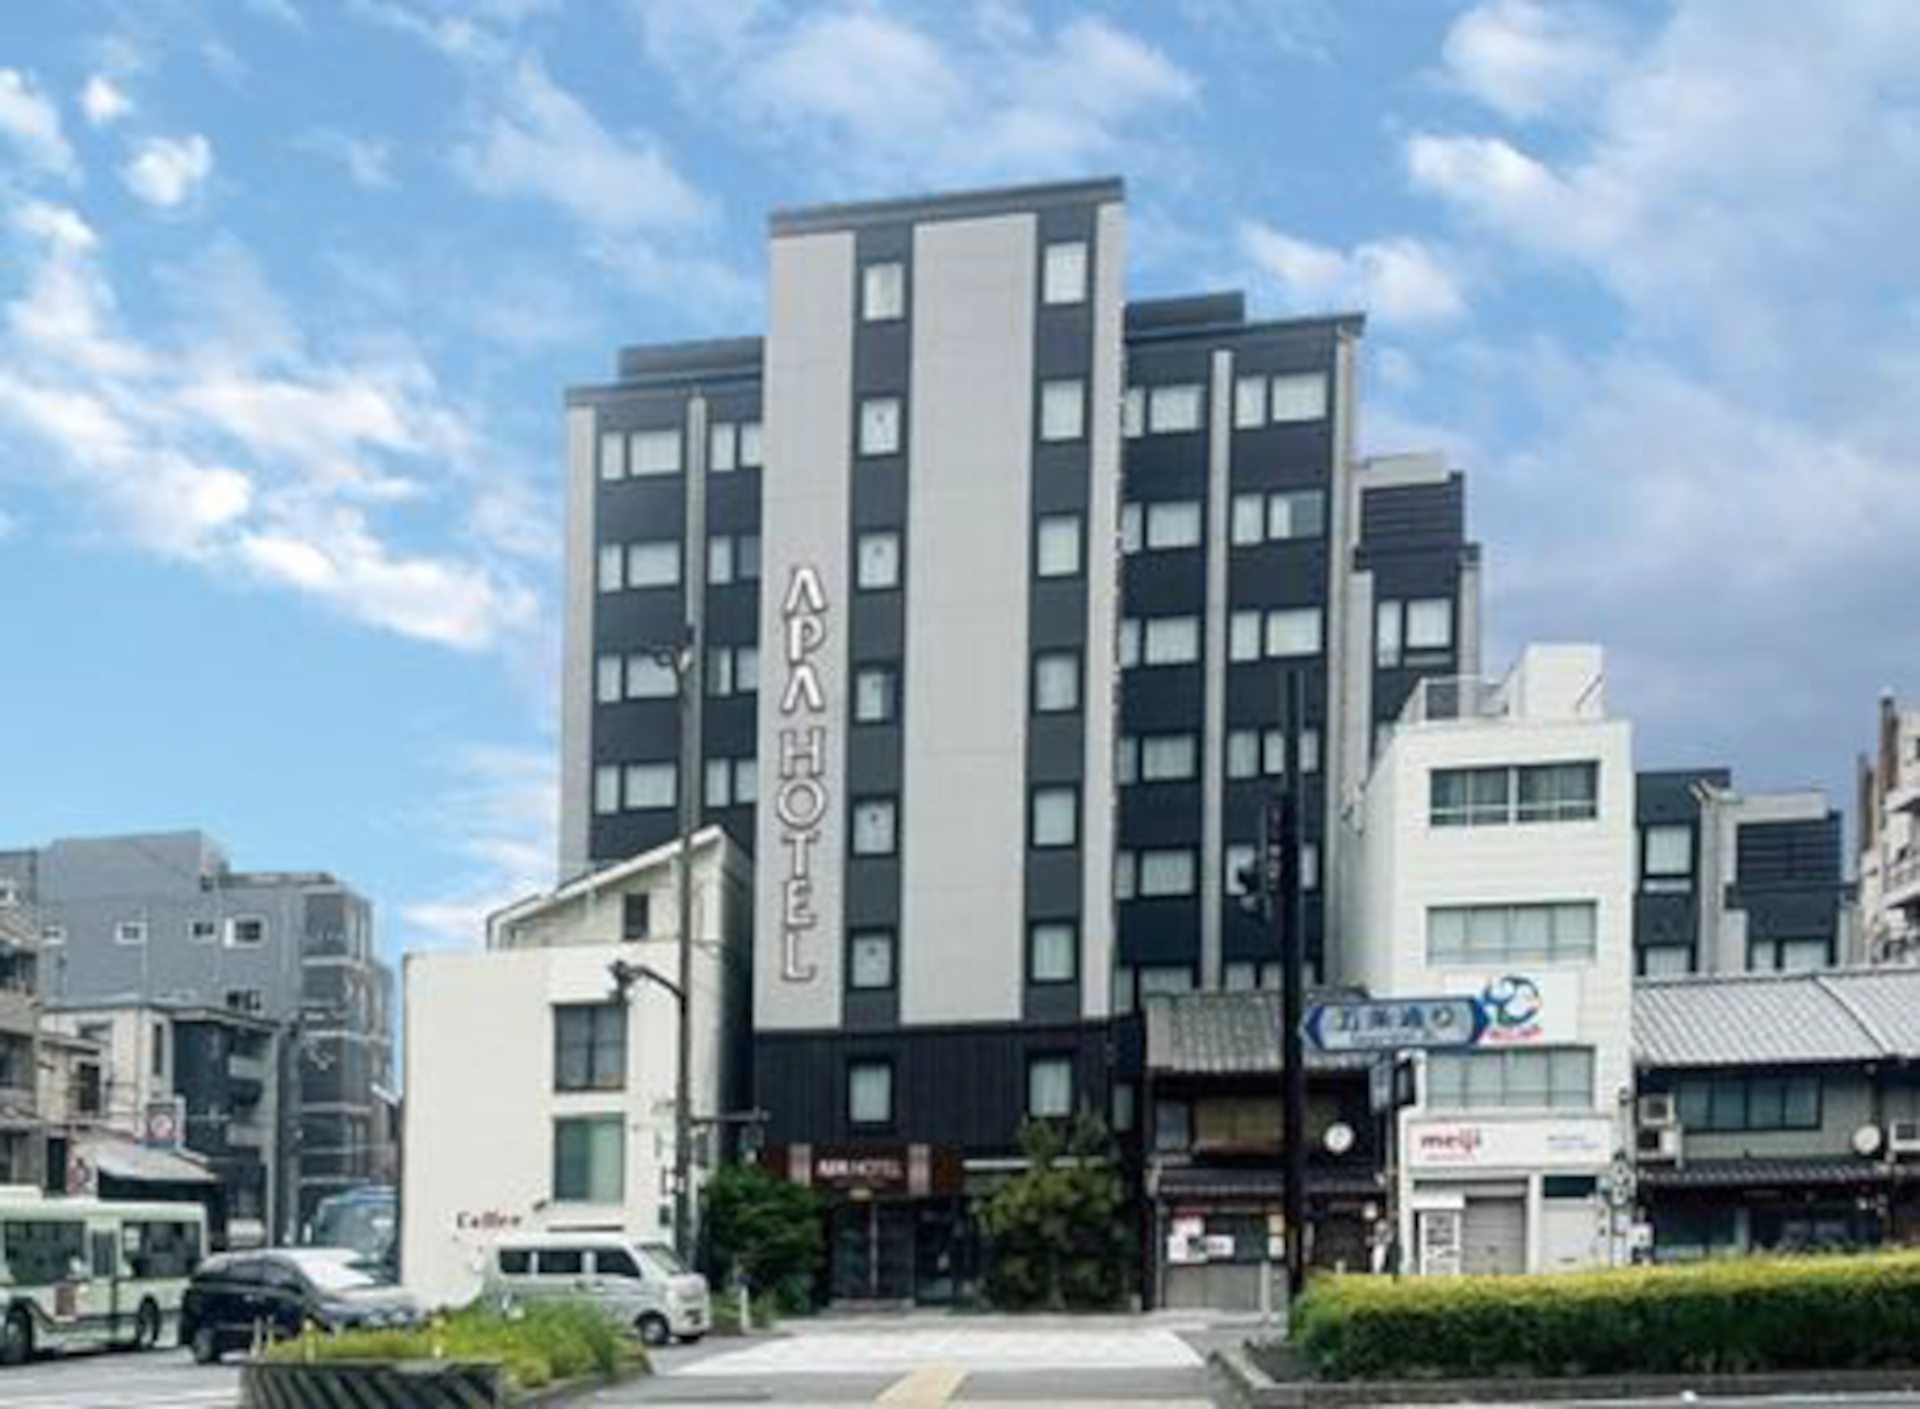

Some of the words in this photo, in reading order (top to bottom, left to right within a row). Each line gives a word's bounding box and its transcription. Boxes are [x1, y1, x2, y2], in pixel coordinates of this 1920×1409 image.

[782, 565, 827, 714] APA
[777, 727, 827, 981] HOTEL
[1420, 1127, 1482, 1153] meiji
